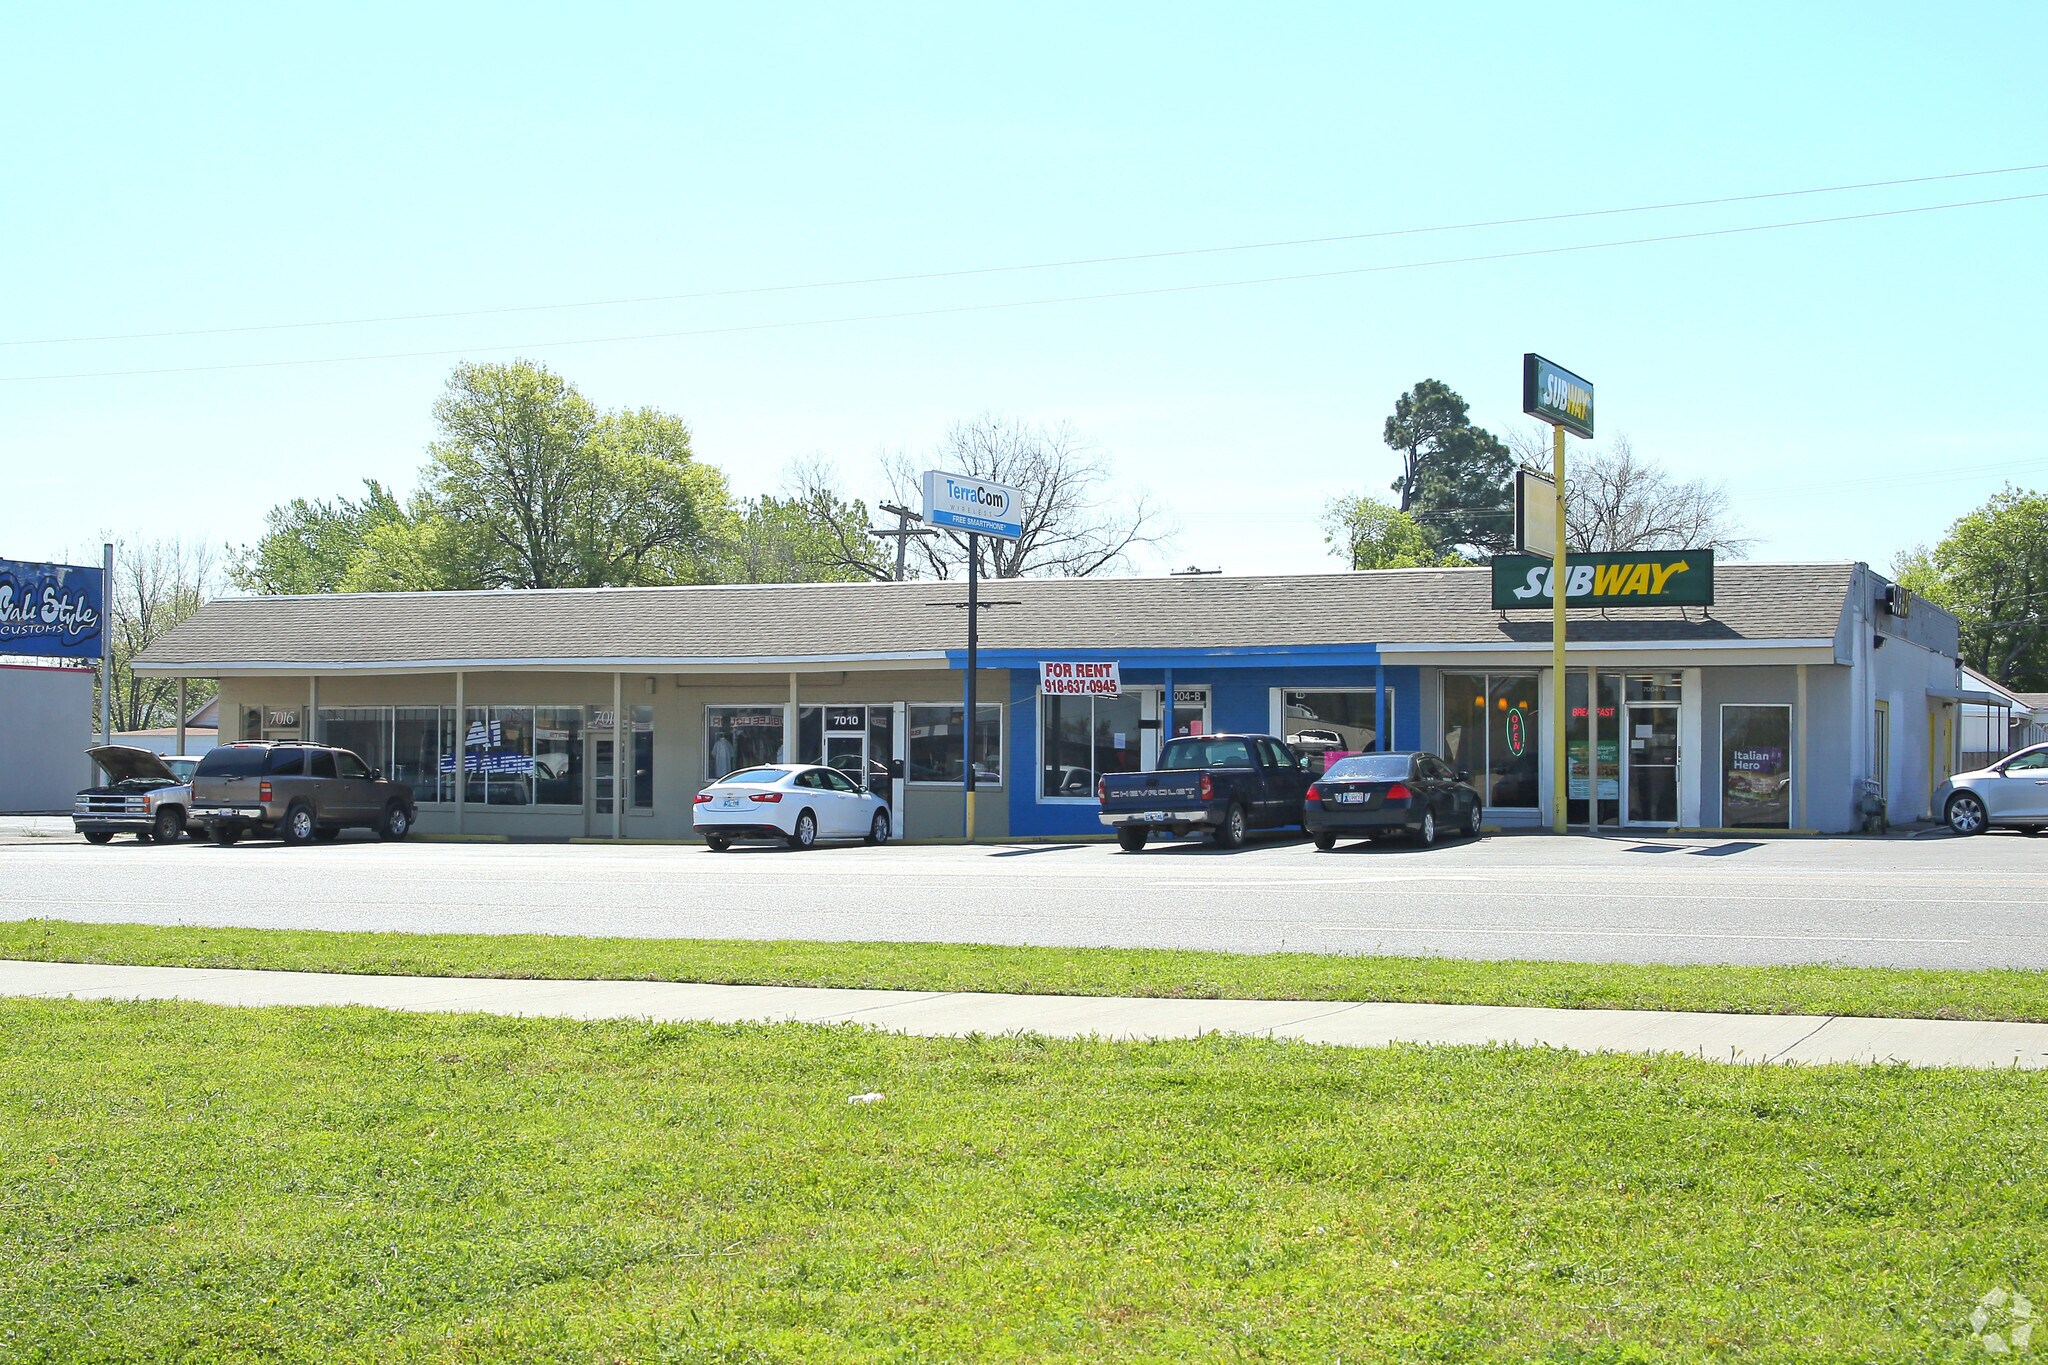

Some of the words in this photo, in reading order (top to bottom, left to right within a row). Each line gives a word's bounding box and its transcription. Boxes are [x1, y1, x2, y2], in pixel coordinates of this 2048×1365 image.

[1543, 374, 1591, 420] SUBWAY
[946, 479, 1003, 508] TerraCom
[950, 505, 992, 517] WIRELESS
[952, 515, 966, 524] FREE
[1512, 560, 1690, 600] SUBWAY
[0, 585, 37, 622] Cali
[41, 586, 99, 635] Style
[0, 623, 64, 635] CUSTOMS
[1045, 662, 1073, 678] FOR
[1075, 663, 1112, 678] RENT
[1044, 678, 1117, 694] 918-637-0945
[1173, 691, 1201, 701] 004-B
[270, 711, 295, 725] 7016
[592, 710, 614, 726] 701
[1571, 707, 1615, 717] BREAFAST
[834, 716, 859, 725] 7010
[1511, 715, 1521, 750] OPEN
[1733, 750, 1769, 760] Italian
[480, 753, 537, 774] AUDIO
[1733, 760, 1760, 770] Hero
[1110, 787, 1195, 798] CHEVROLET
